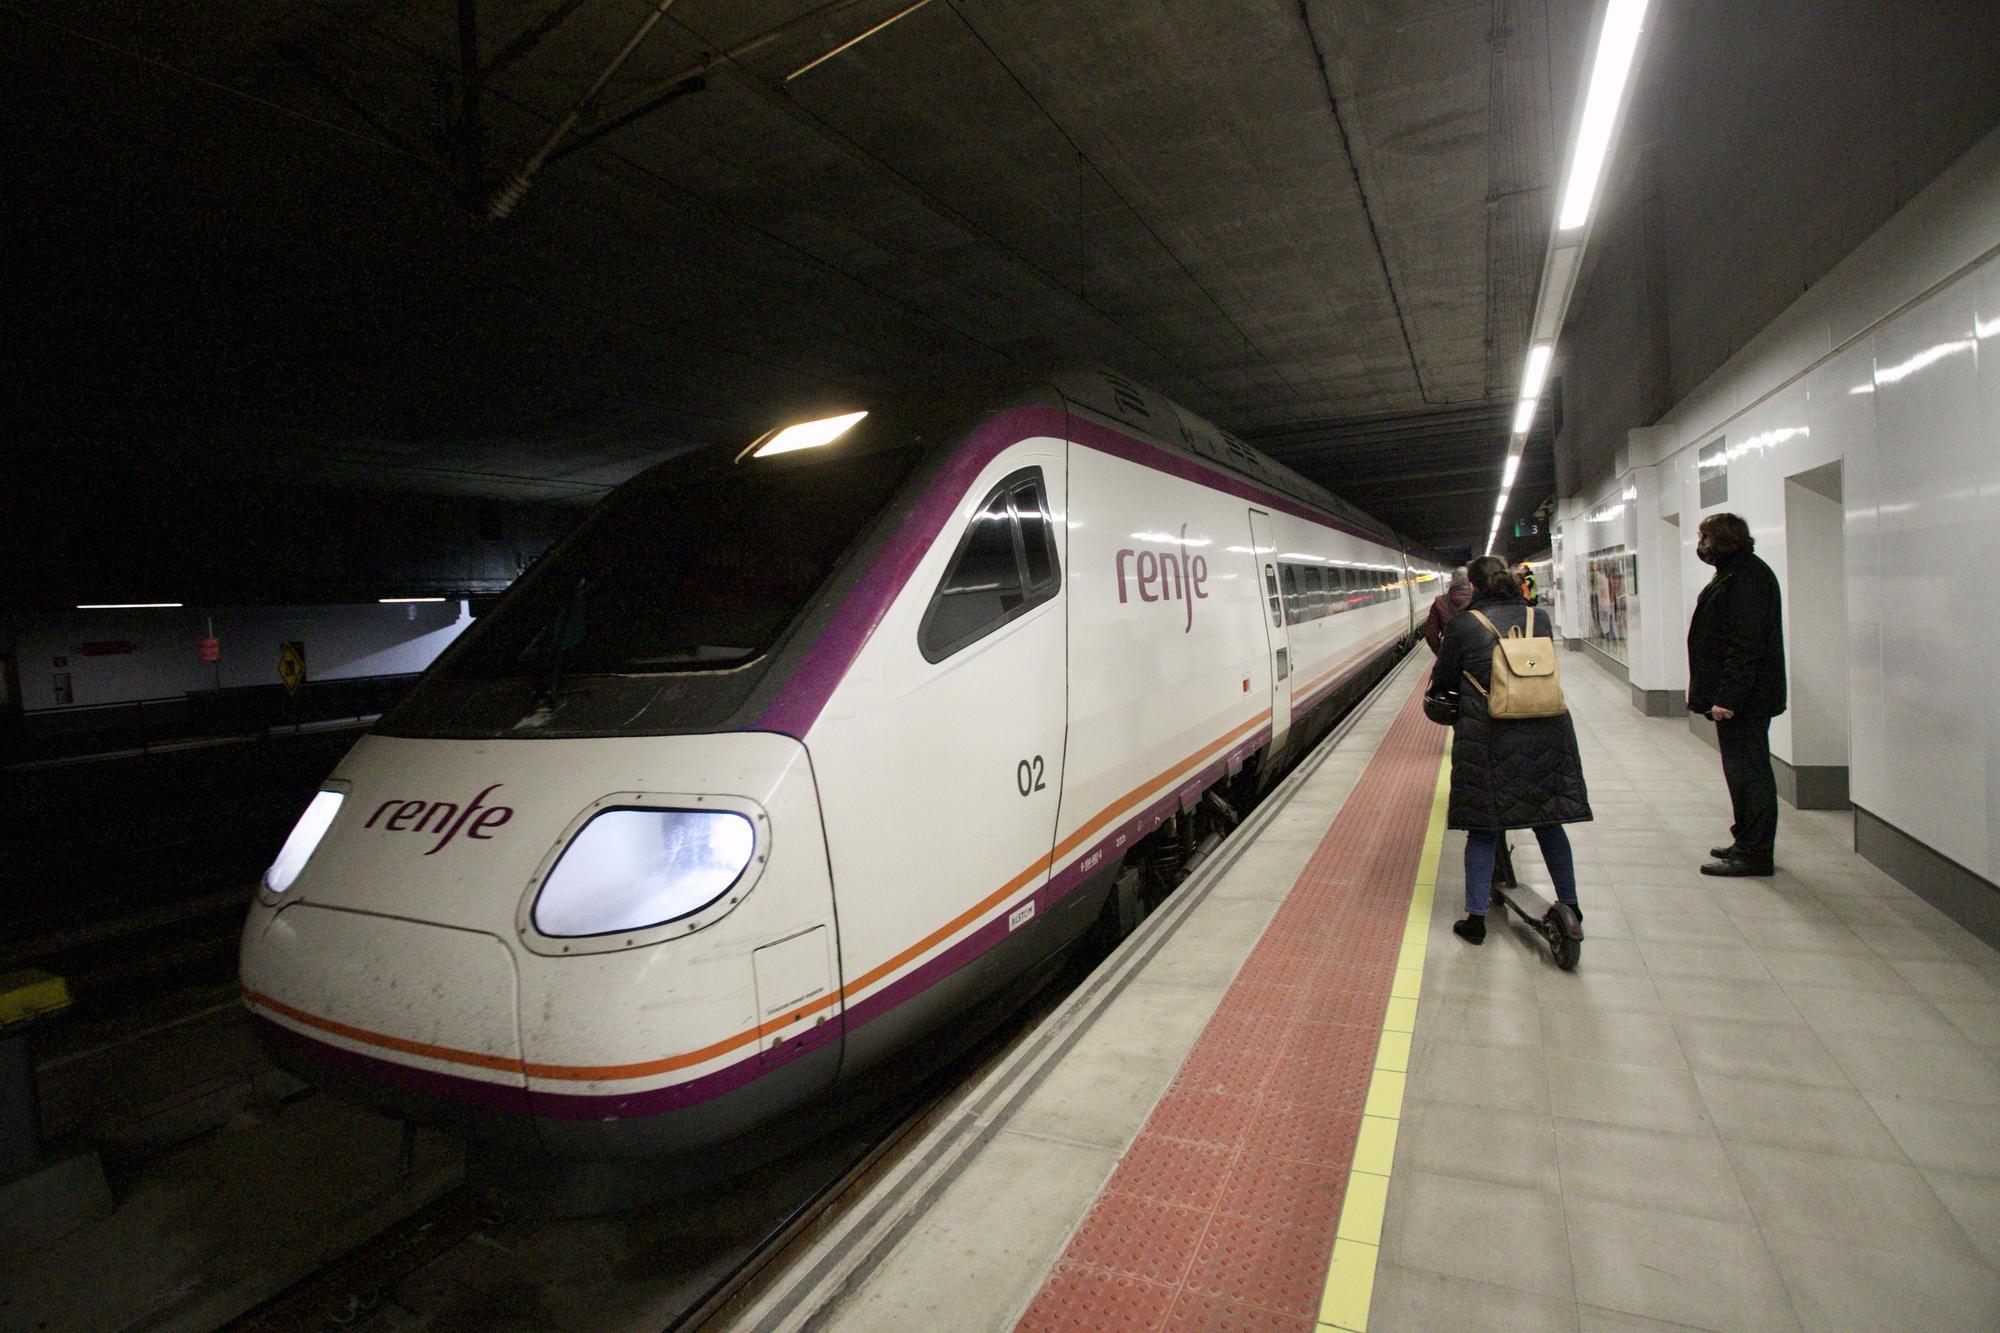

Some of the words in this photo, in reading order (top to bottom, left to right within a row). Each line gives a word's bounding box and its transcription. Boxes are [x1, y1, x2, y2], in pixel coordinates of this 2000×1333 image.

[1531, 525, 1538, 535] 3
[1116, 523, 1208, 633] renfe
[1017, 755, 1046, 797] 02
[365, 784, 513, 855] renfe
